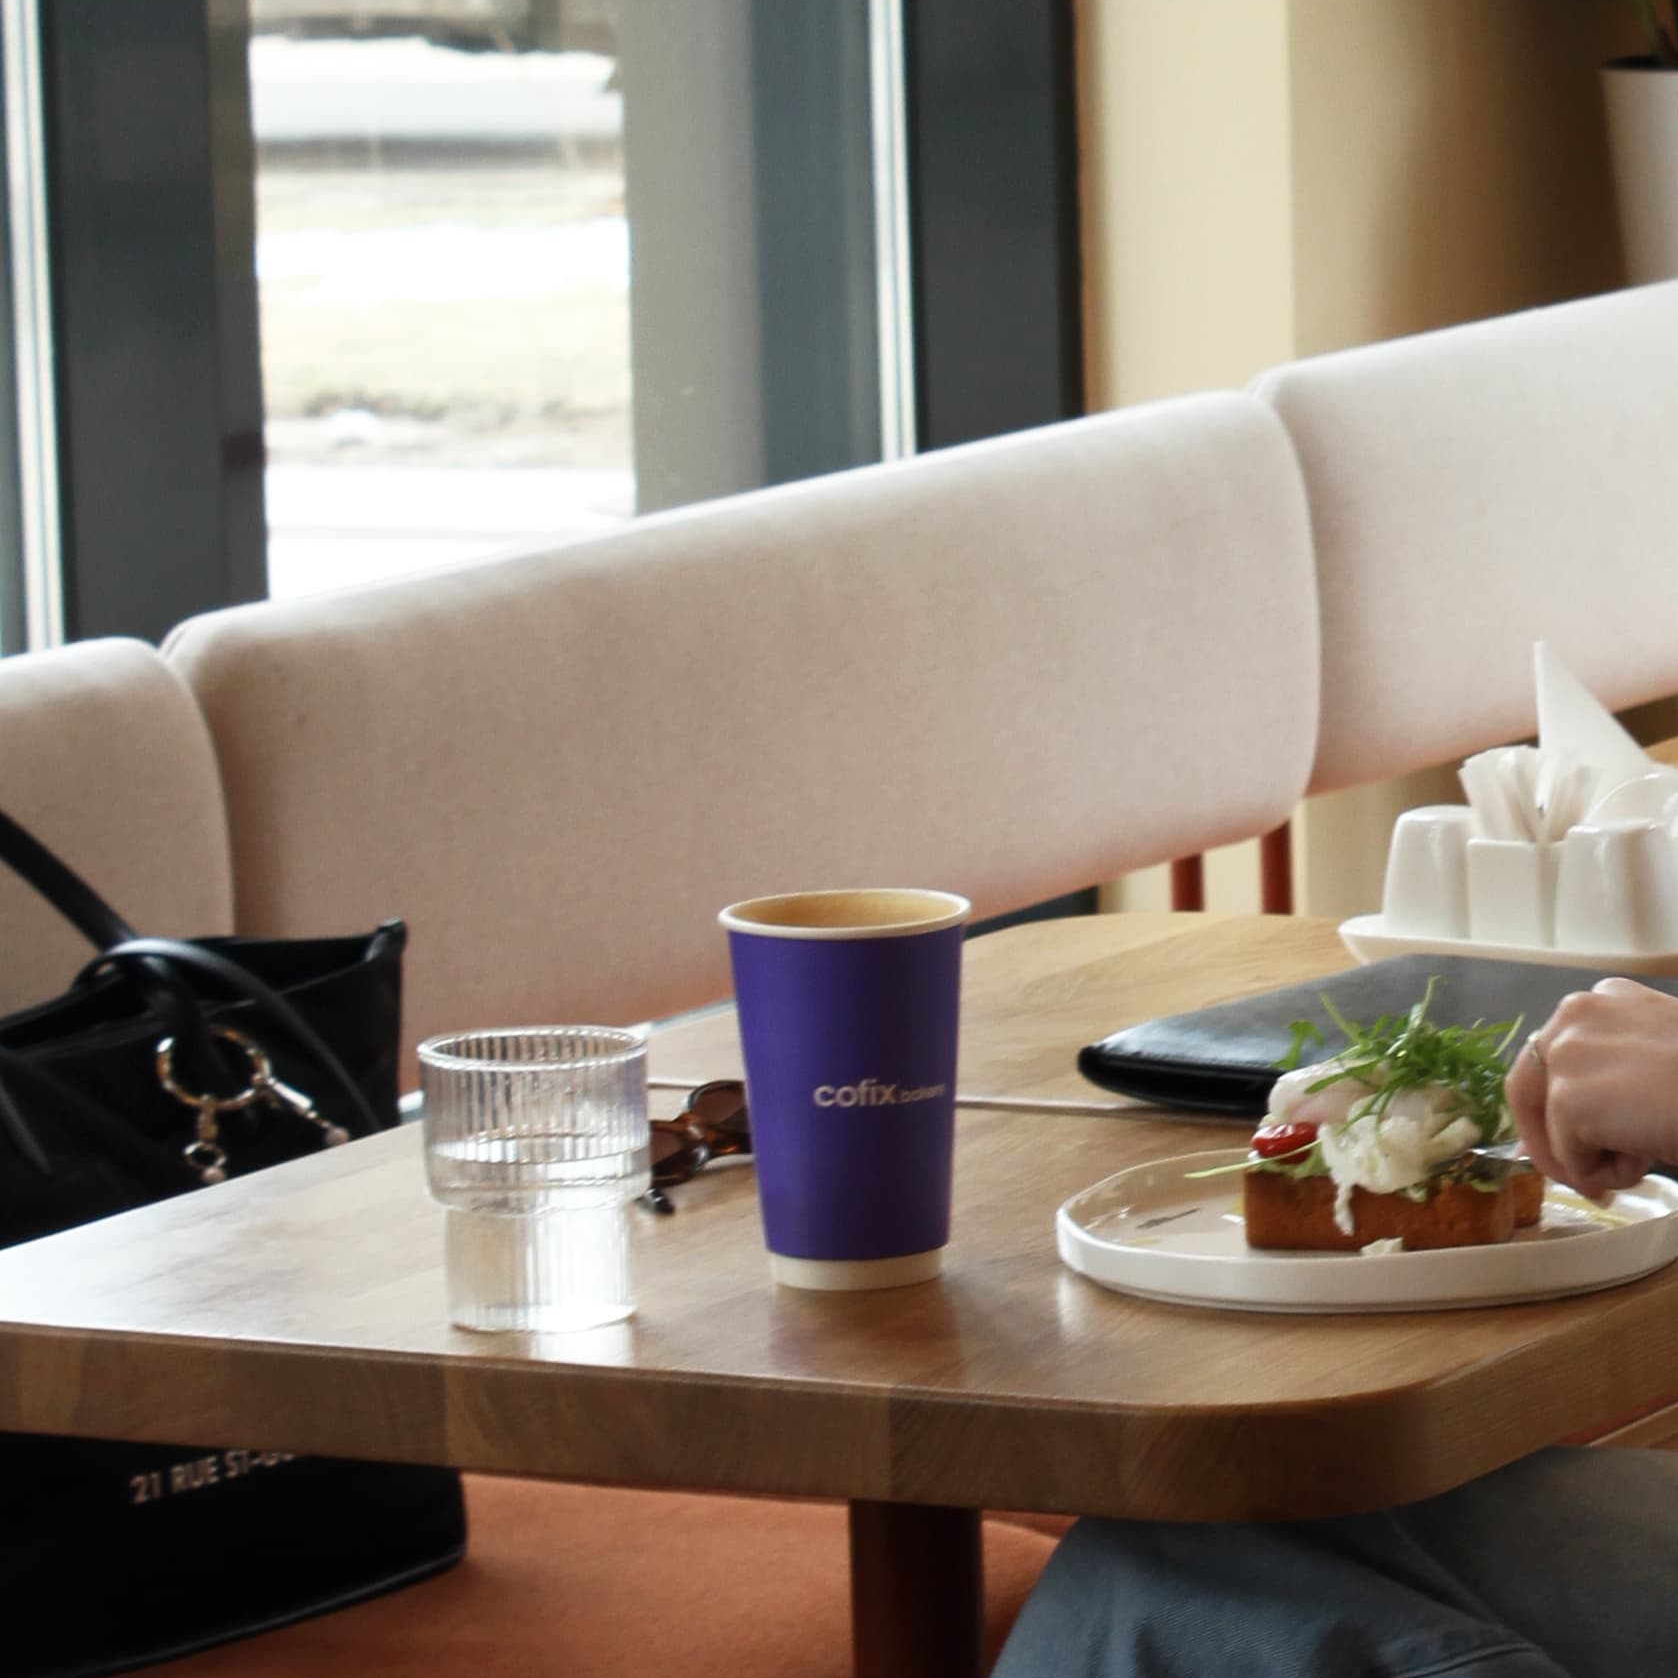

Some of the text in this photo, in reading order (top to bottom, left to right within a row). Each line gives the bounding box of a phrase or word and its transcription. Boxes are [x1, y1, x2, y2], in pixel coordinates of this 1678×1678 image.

[814, 1078, 897, 1107] cofix
[129, 1473, 161, 1505] 21
[171, 1455, 219, 1493] RUE
